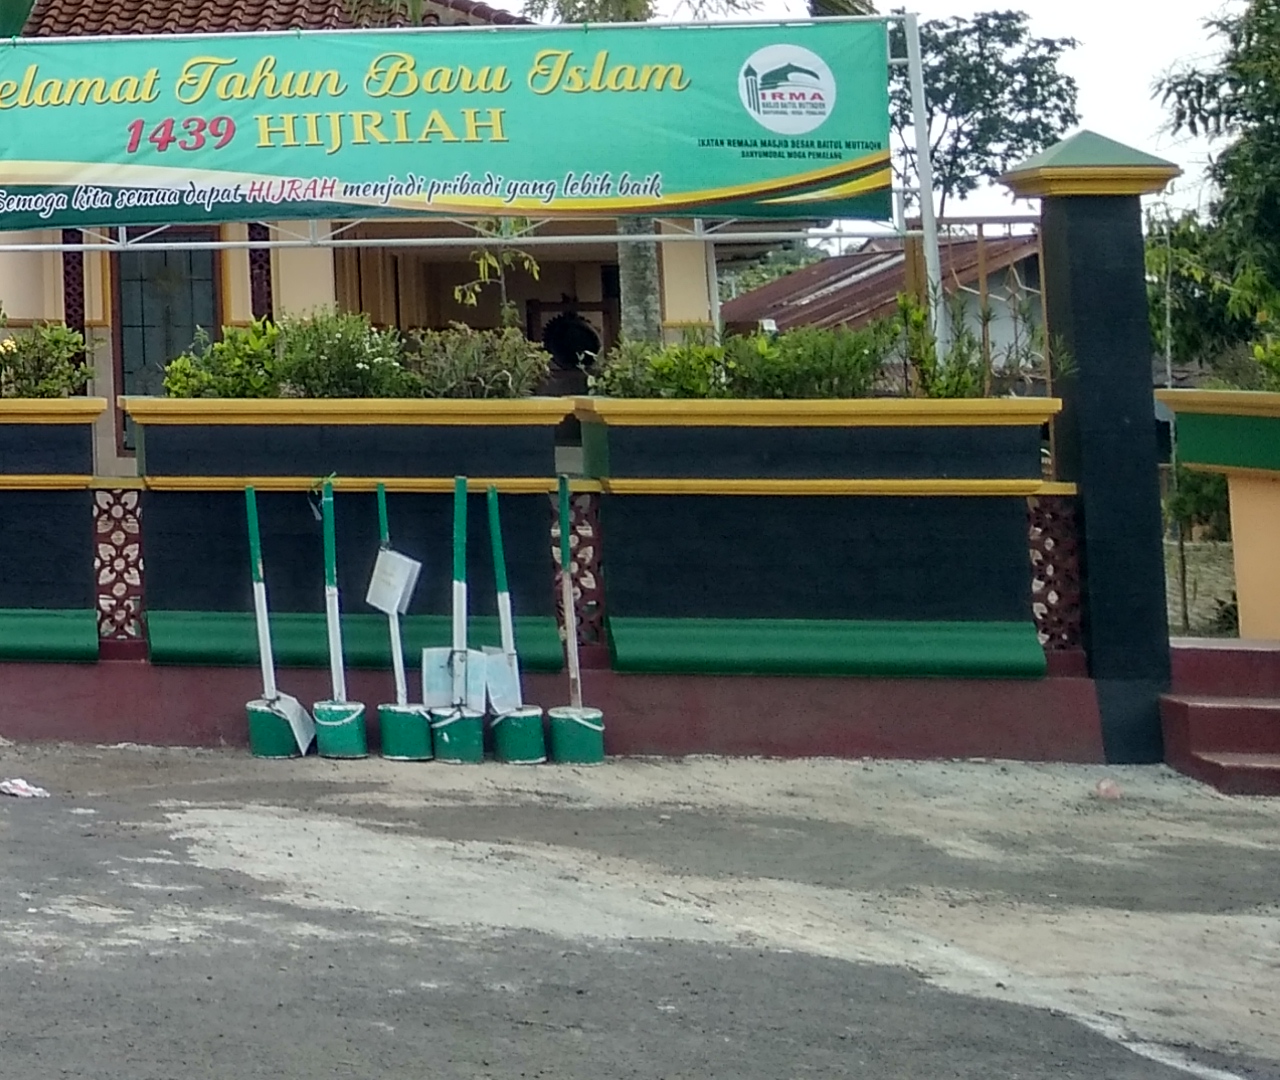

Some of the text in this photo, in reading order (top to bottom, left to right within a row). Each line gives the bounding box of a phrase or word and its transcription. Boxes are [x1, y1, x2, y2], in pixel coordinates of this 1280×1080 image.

[175, 54, 348, 105] Tahun
[363, 52, 512, 98] Baru
[527, 49, 692, 95] Islam
[761, 92, 825, 101] IRMA
[126, 108, 510, 155] 1439 HIJRIAH
[698, 138, 725, 148] IKATAN
[727, 138, 758, 149] REMAJA
[760, 139, 789, 150] MASJID
[791, 140, 815, 150] BESAR
[817, 140, 843, 150] BAITUL
[71, 184, 112, 211] kita
[115, 190, 180, 208] semua
[183, 182, 243, 212] dapat
[246, 177, 337, 204] HIJRAH
[342, 174, 423, 204] menjadi
[427, 172, 502, 205] pribadi
[504, 177, 557, 204] yang
[561, 171, 612, 198] lebih
[617, 170, 664, 199] baik
